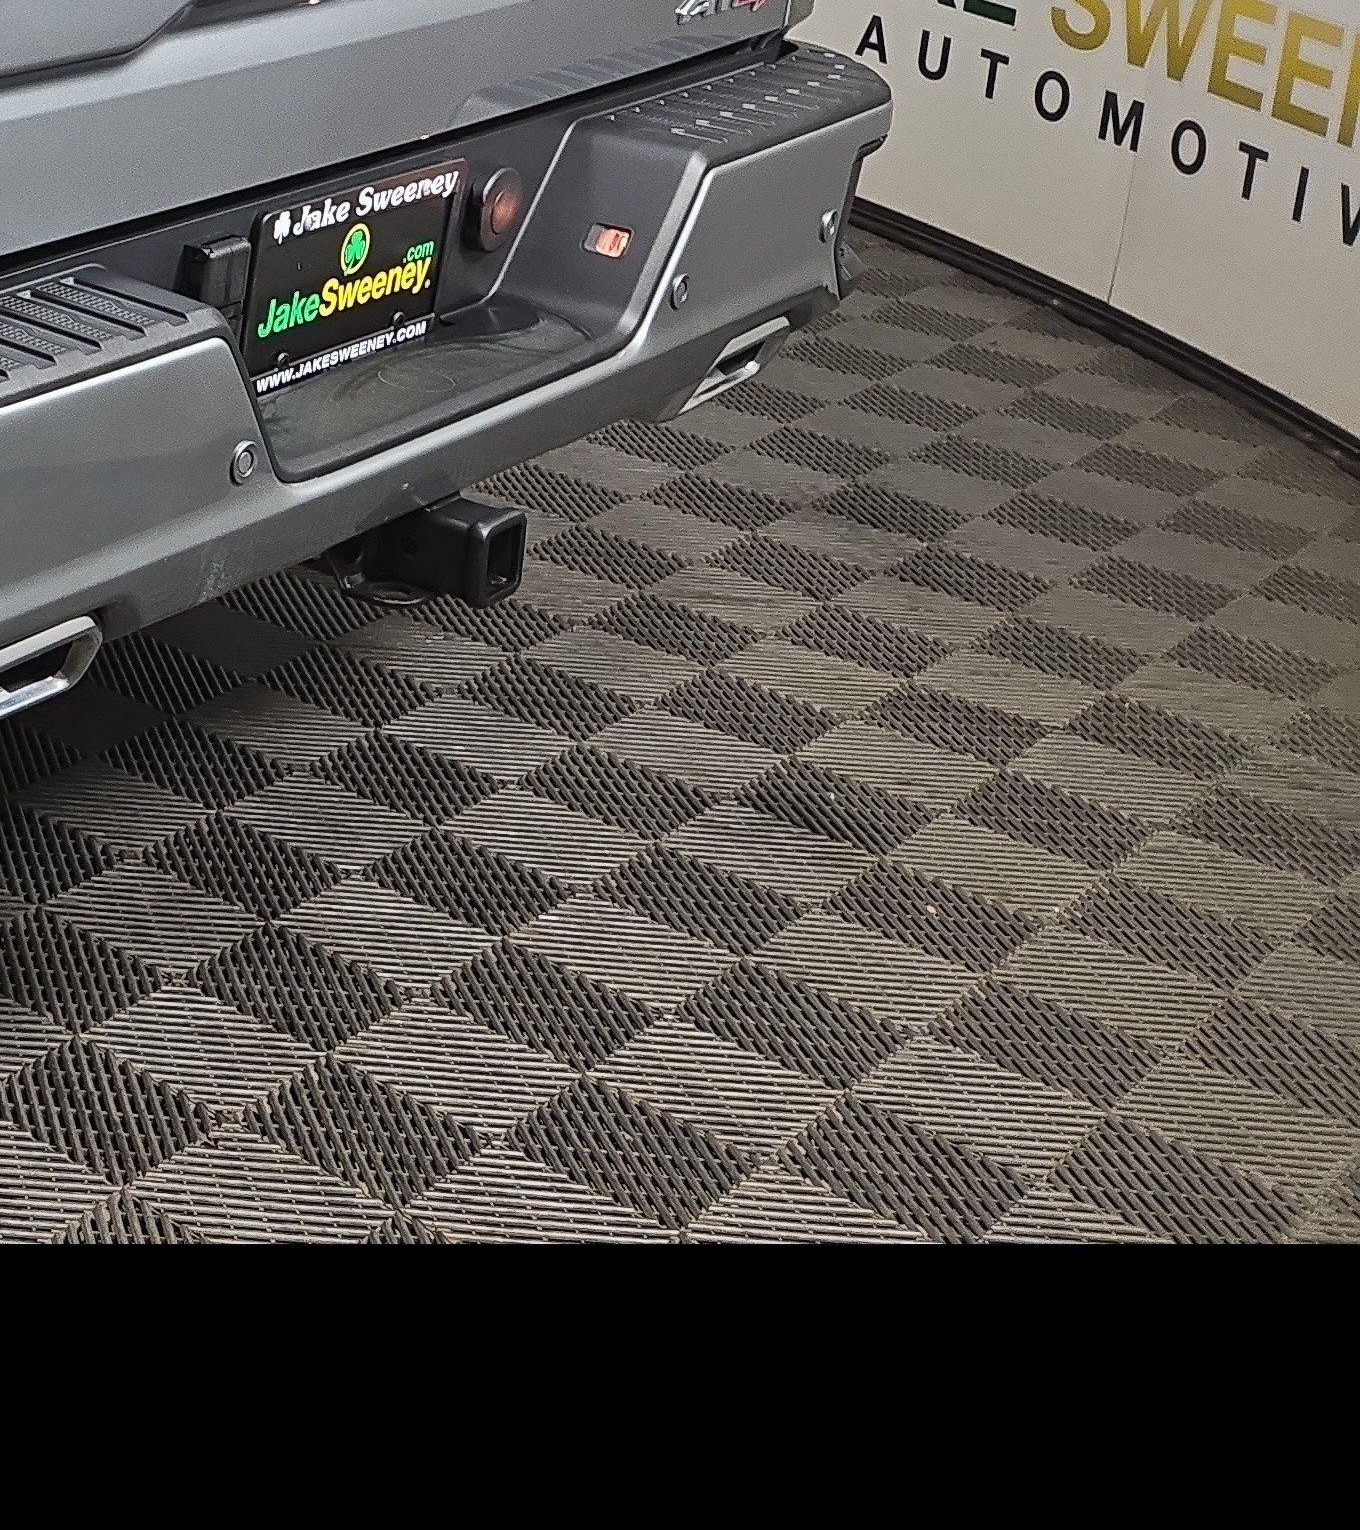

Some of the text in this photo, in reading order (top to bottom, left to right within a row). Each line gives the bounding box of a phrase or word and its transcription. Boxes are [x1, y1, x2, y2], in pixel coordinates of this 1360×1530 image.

[292, 170, 460, 237] Jake Sweeney
[402, 240, 436, 264] .com
[256, 320, 428, 394] WWW.JAKESWEENEY.COM
